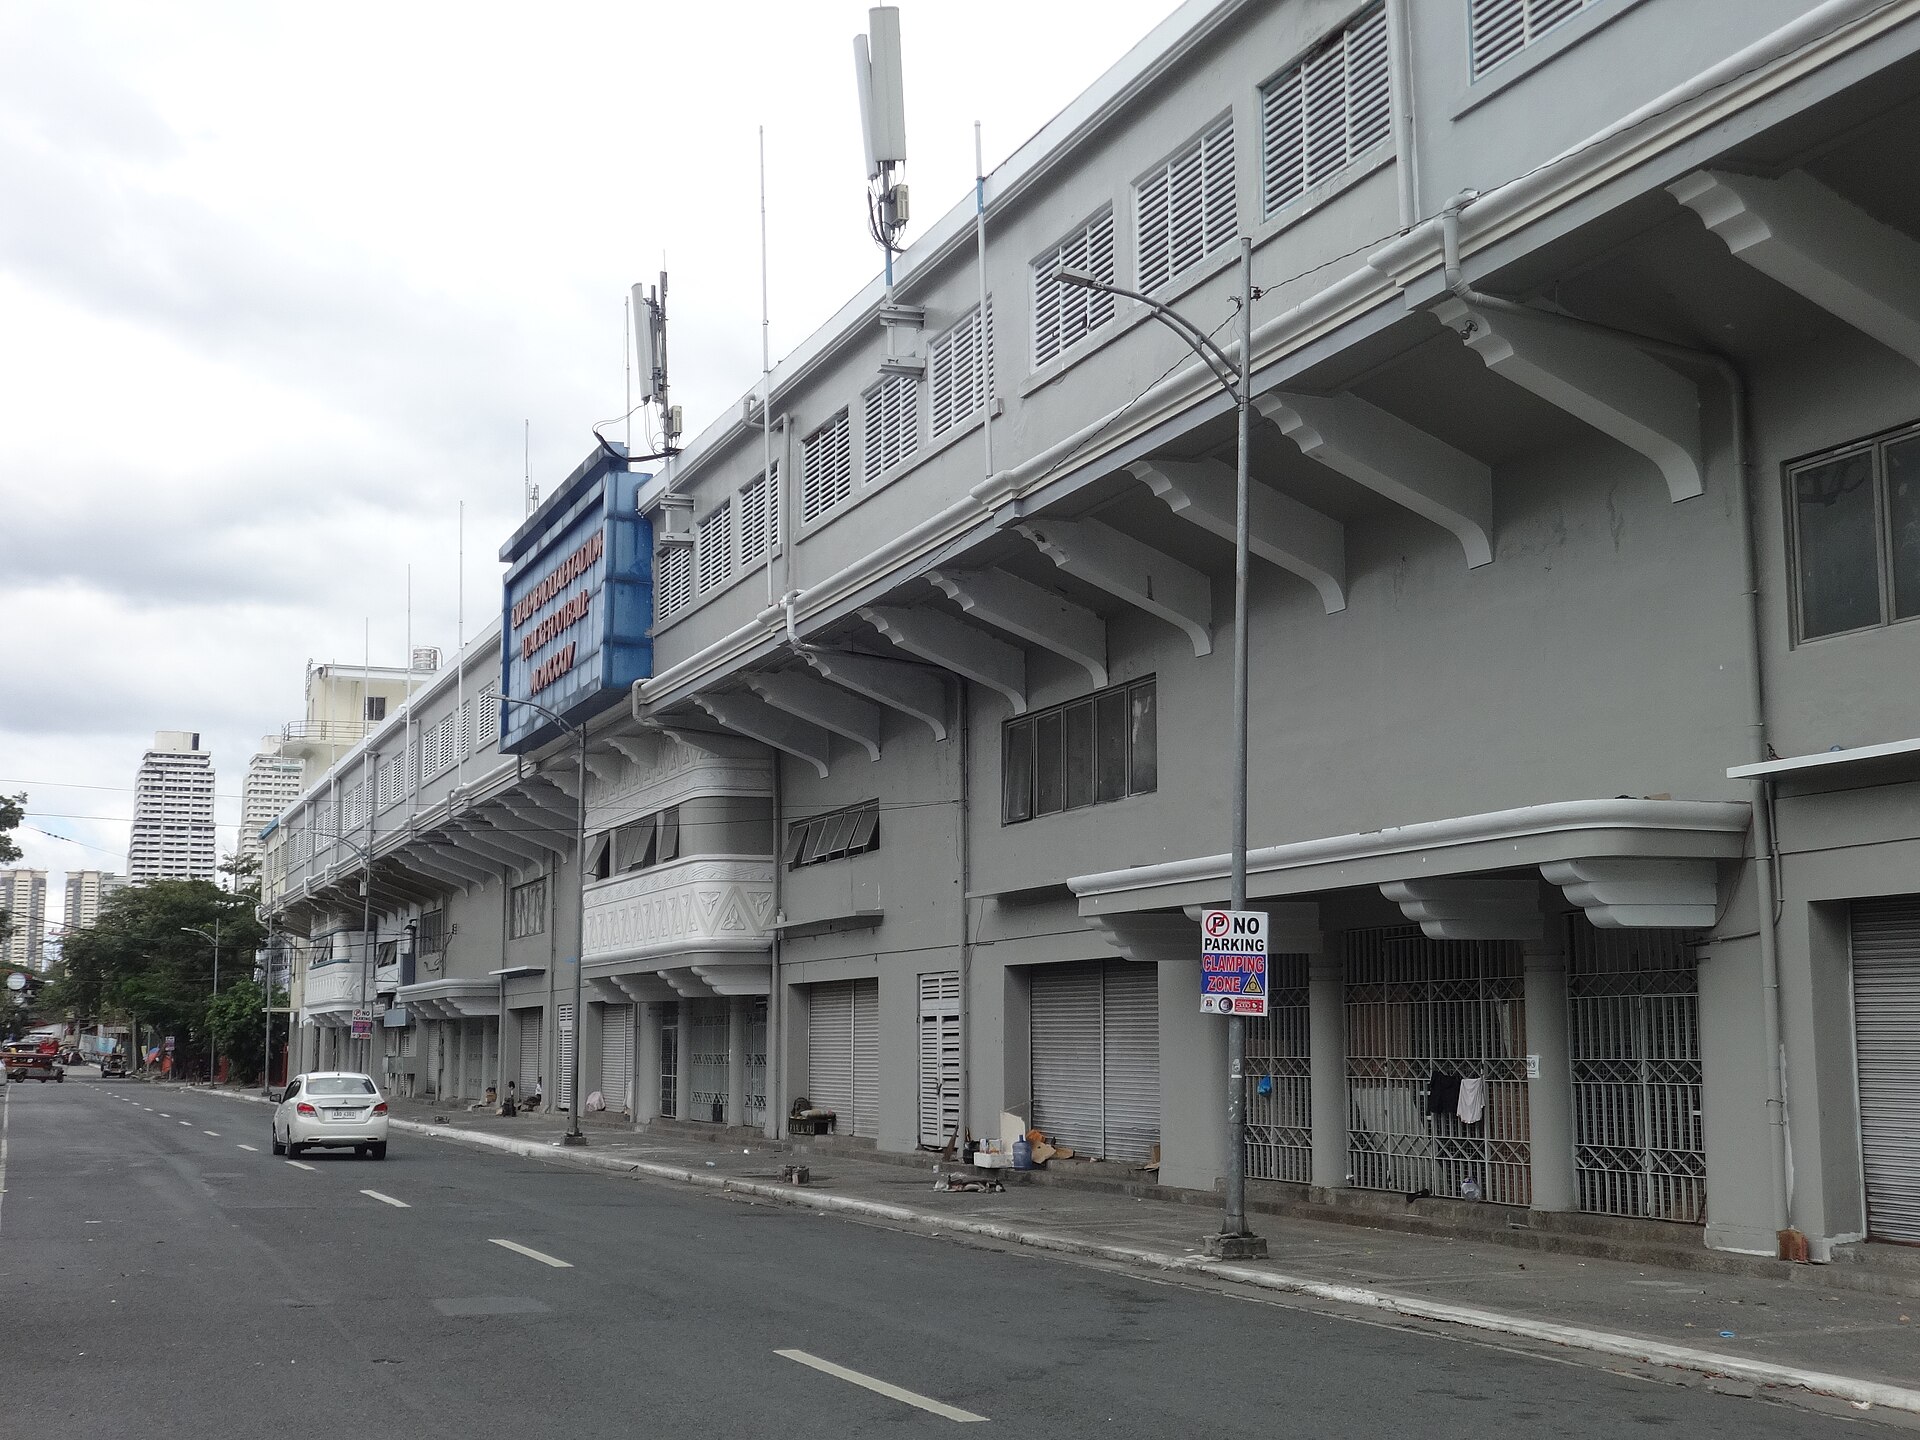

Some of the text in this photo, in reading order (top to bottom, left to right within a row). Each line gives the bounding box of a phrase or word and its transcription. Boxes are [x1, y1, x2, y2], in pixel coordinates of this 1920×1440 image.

[1234, 917, 1260, 934] NO
[1204, 937, 1264, 952] PARKING
[1203, 955, 1264, 974] CLAMPING
[1208, 975, 1240, 993] ZONE
